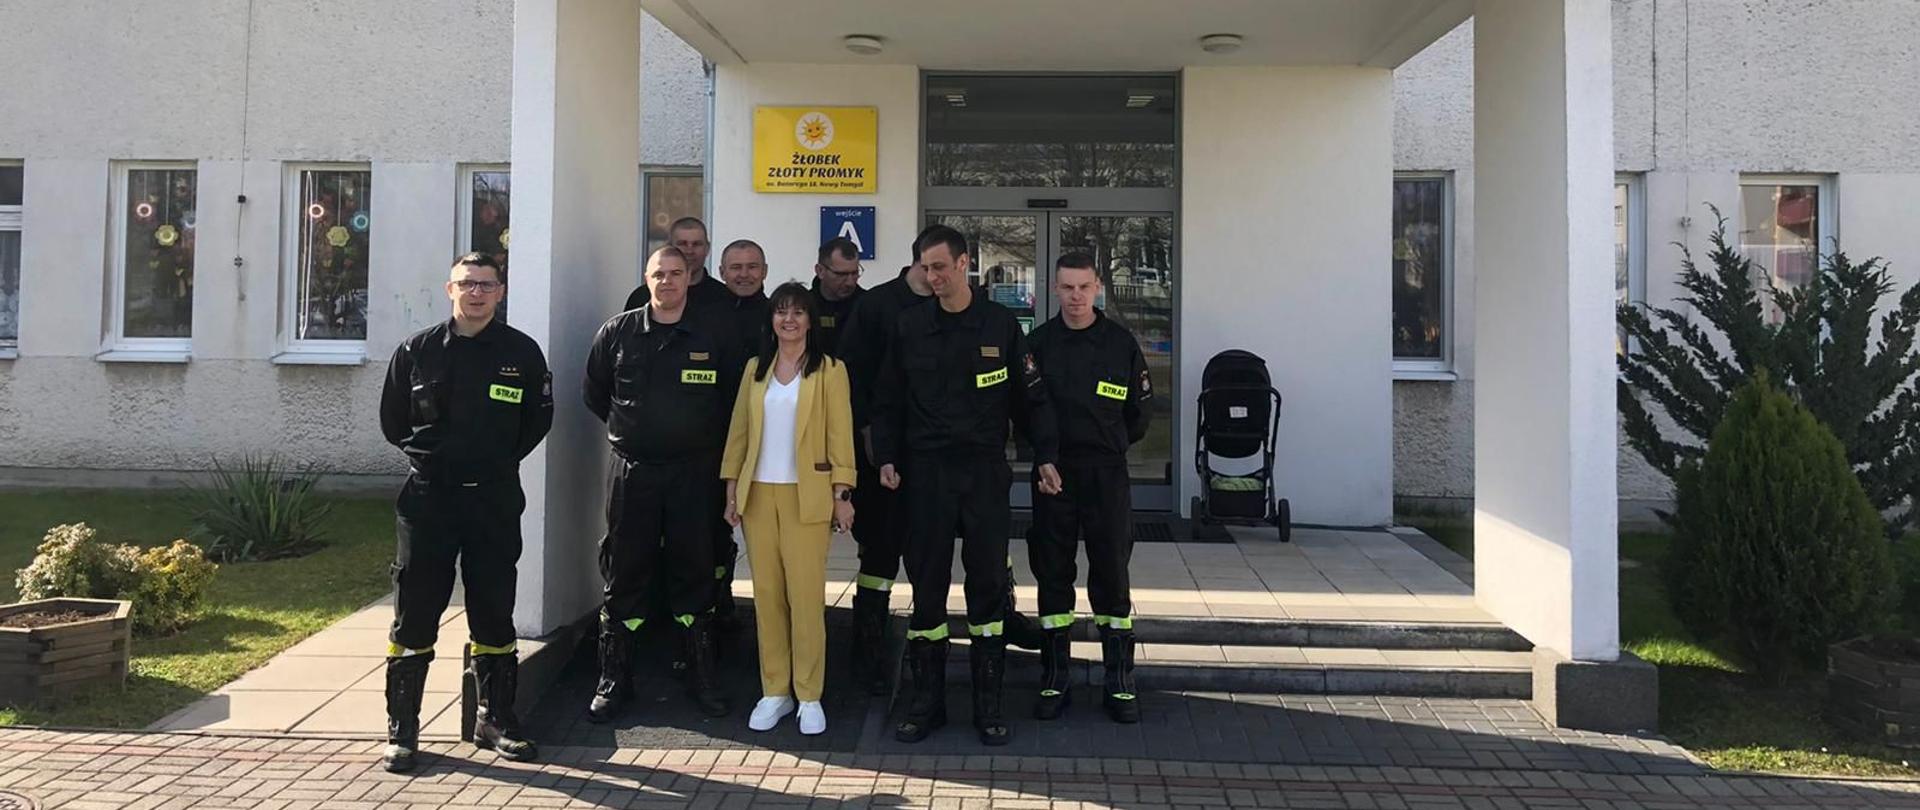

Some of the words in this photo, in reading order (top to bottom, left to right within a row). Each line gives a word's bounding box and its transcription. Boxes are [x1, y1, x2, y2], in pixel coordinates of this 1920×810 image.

[792, 152, 841, 165] ŻŁOBEK
[768, 167, 807, 177] ZŁOTY
[809, 167, 864, 178] PROMYK
[835, 209, 862, 218] wejście
[838, 221, 864, 252] A
